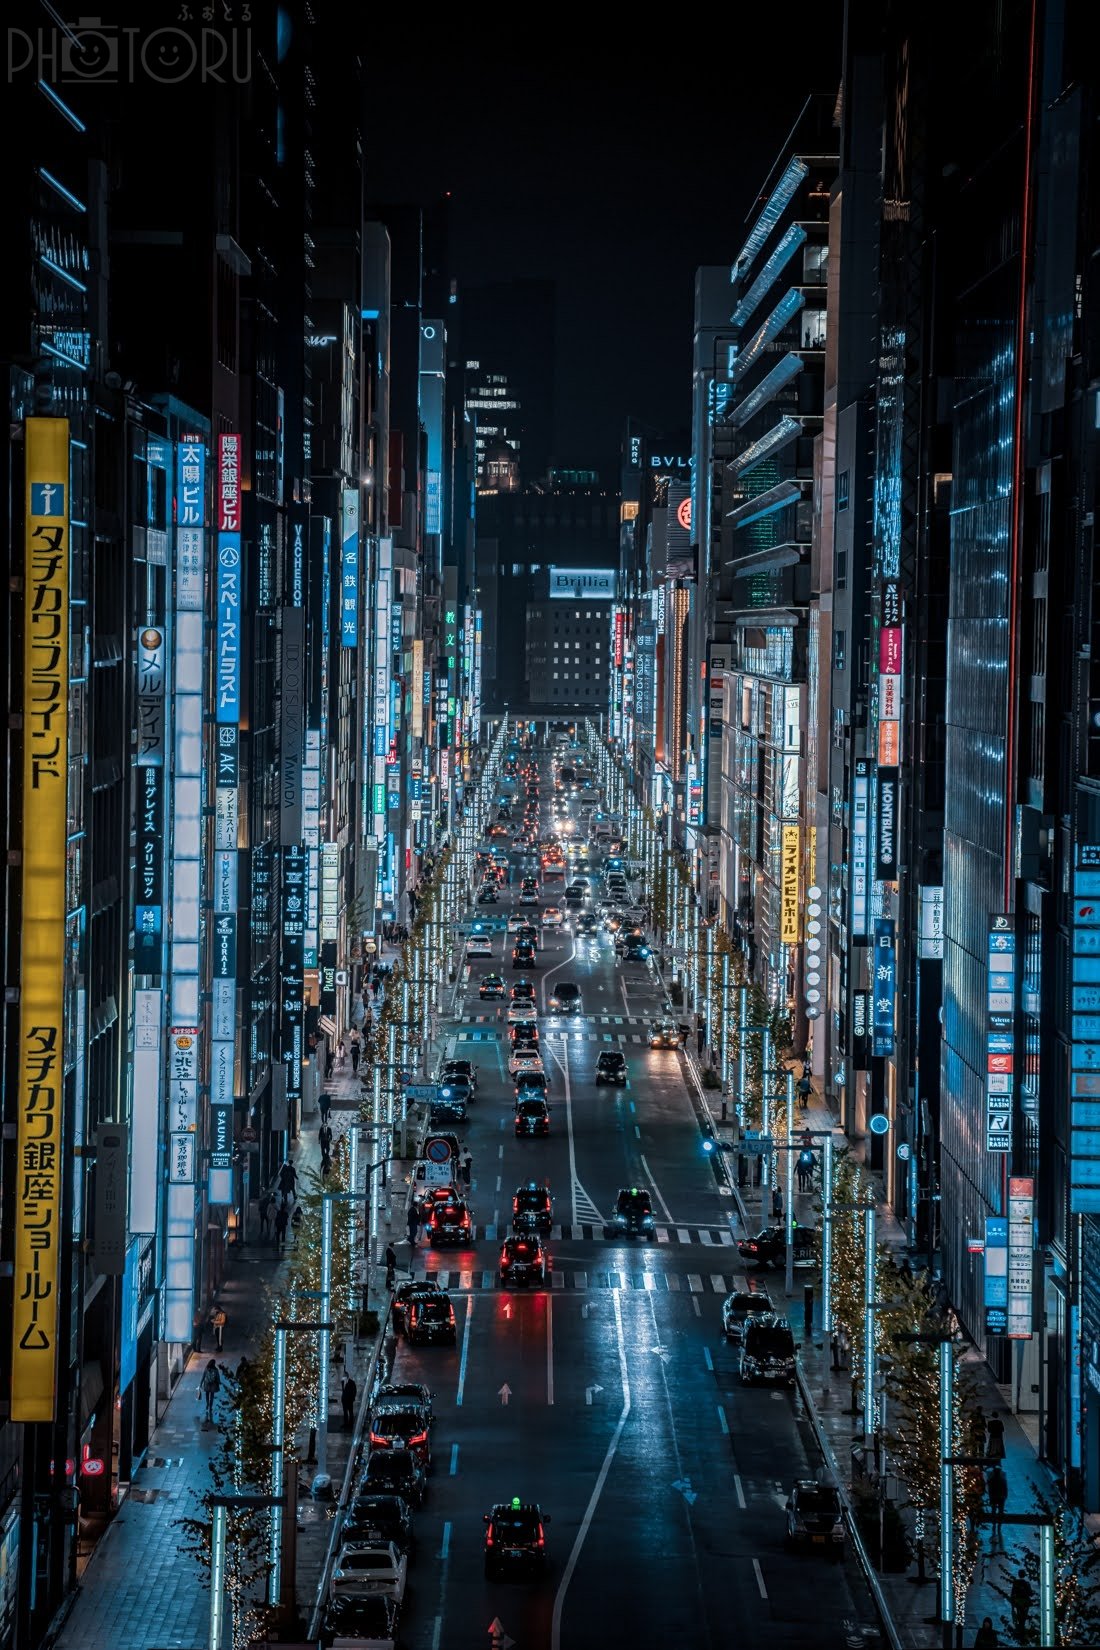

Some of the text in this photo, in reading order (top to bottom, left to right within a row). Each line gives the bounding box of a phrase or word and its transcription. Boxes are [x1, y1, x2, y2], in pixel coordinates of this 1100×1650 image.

[182, 445, 200, 524] 太陽ビル
[222, 436, 237, 530] 陽栄銀座ビル
[294, 524, 302, 607] VACHERON
[344, 553, 357, 634] 名鉄観光
[557, 575, 609, 587] Brillia
[220, 573, 237, 708] スペーストラスト
[658, 584, 666, 635] MITSUKOSHI
[31, 526, 63, 790] タチカワブラインド
[141, 653, 161, 756] メルディア
[885, 678, 893, 717] 共立美容外科
[219, 752, 235, 774] AK
[284, 753, 298, 809] YAMADA
[144, 767, 157, 899] 銀座グレイス クリニック
[225, 788, 235, 849] ランドエスパース
[882, 782, 893, 854] MONTBLANC
[785, 844, 797, 934] ライオンビヤホール
[221, 935, 229, 975] TORAIZ
[323, 967, 335, 992] PIAGET
[876, 936, 893, 1013] 日新堂
[854, 994, 864, 1026] YAMAHA
[219, 1046, 230, 1100] WATCHNIAN
[217, 1111, 226, 1151] SAUNA
[19, 1025, 64, 1351] タチカワ銀座ショールーム
